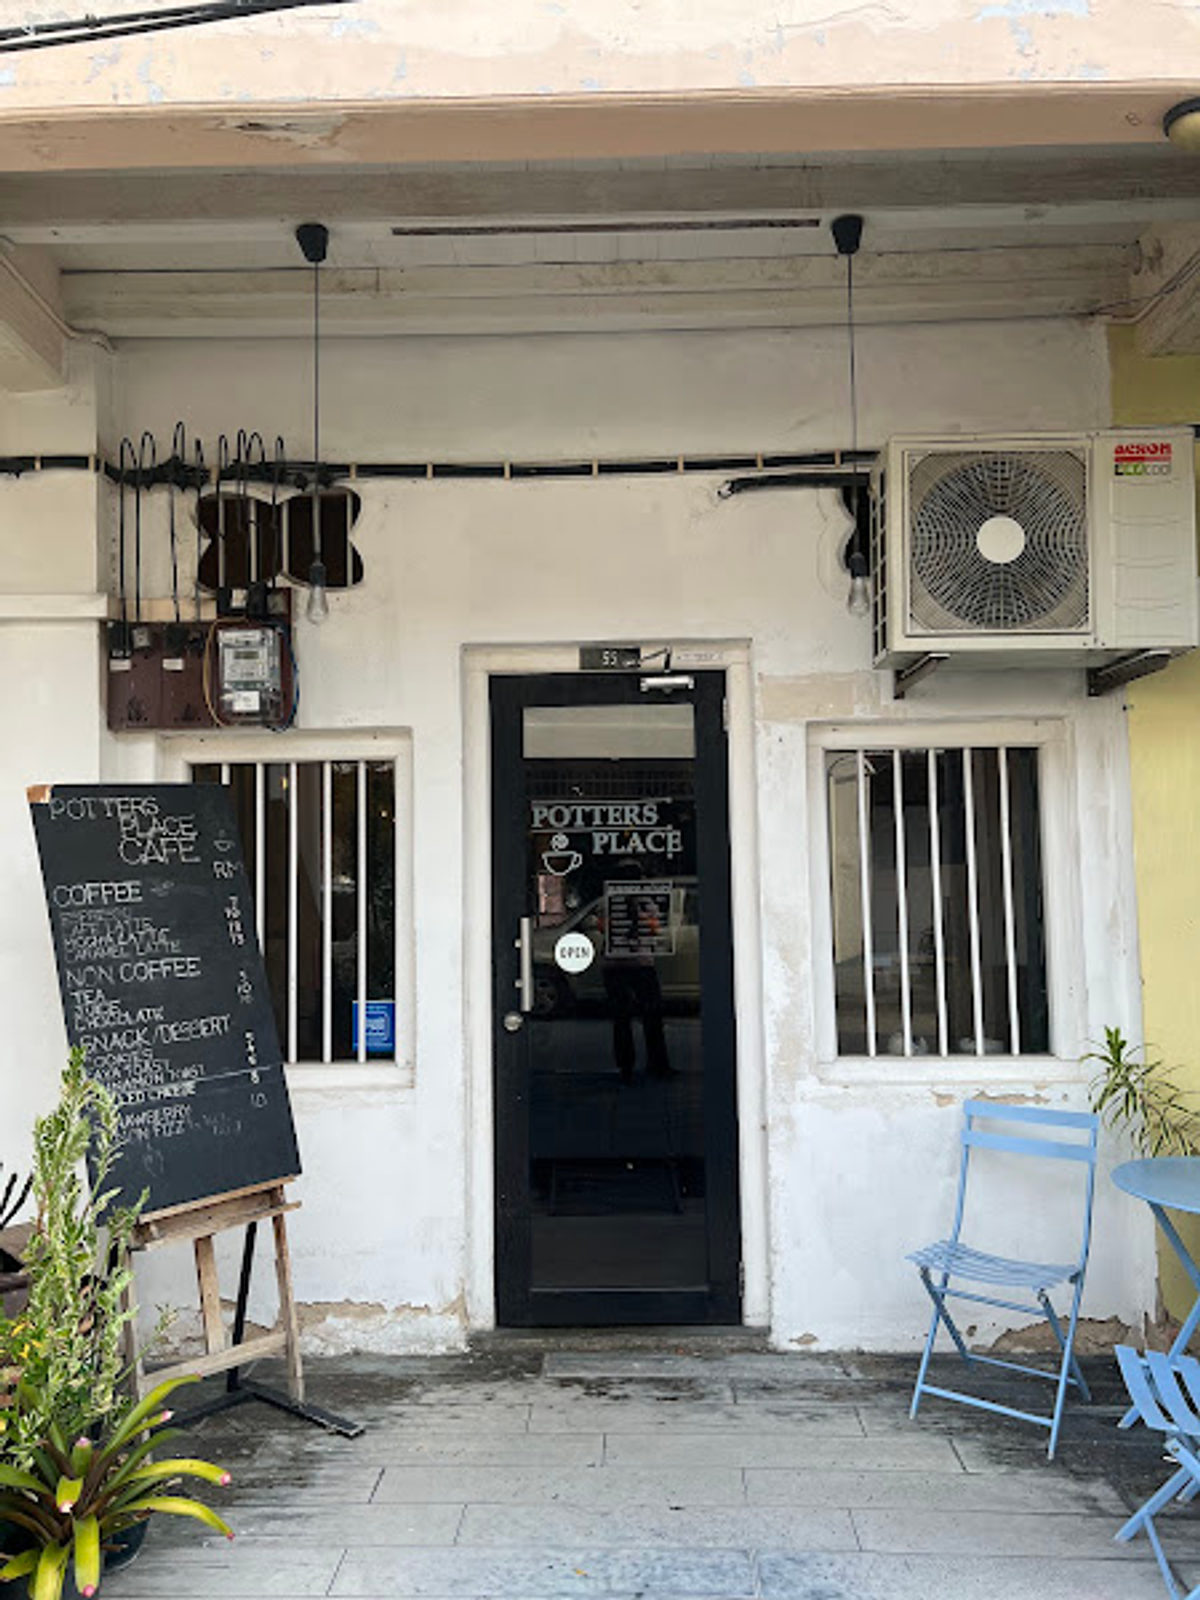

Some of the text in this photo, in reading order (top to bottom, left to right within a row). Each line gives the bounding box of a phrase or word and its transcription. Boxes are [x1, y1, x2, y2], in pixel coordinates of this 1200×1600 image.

[49, 797, 161, 821] POTTERS
[531, 804, 660, 828] POTTERS
[592, 830, 683, 855] PLACE
[52, 880, 143, 907] COFFEE
[66, 957, 201, 988] NON COFFEE
